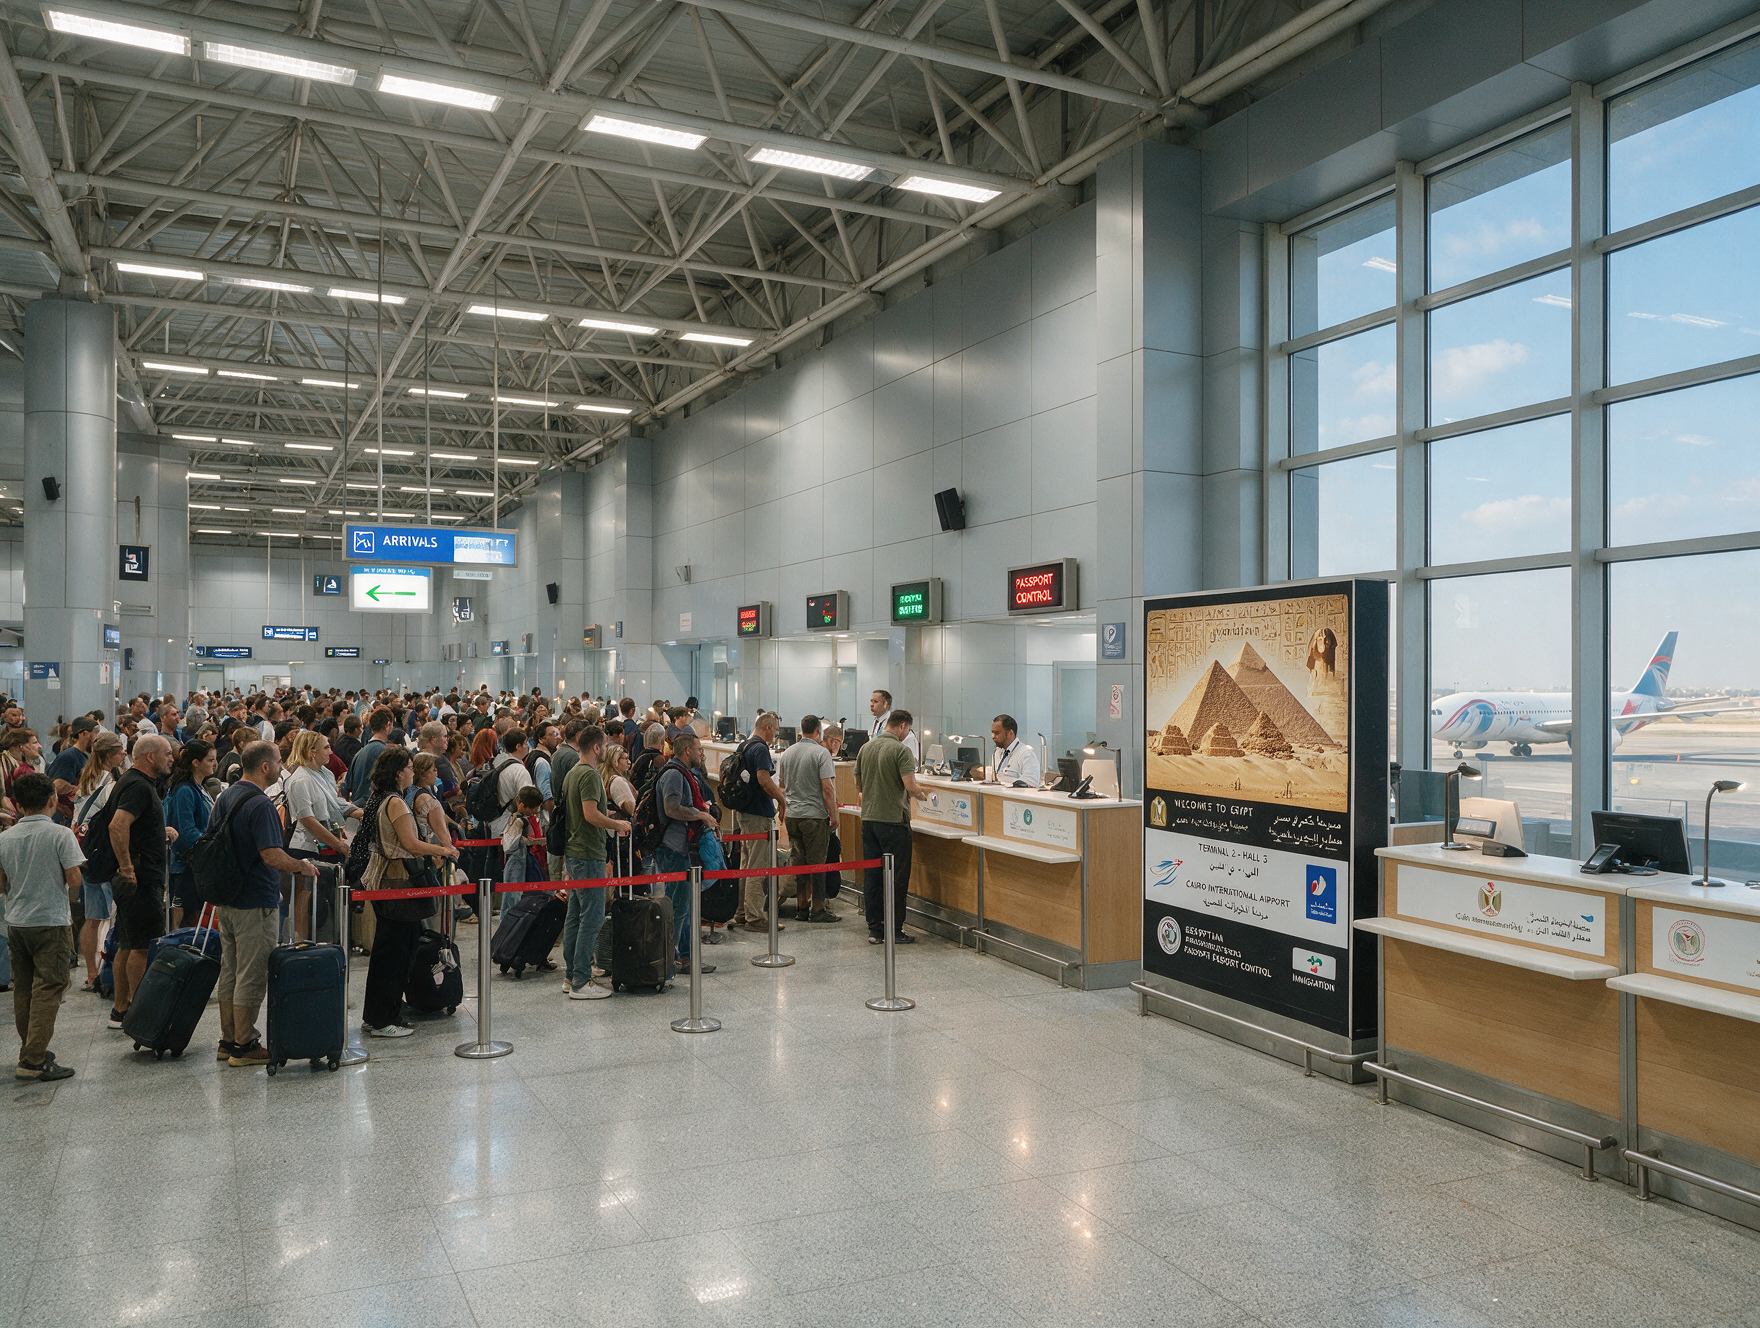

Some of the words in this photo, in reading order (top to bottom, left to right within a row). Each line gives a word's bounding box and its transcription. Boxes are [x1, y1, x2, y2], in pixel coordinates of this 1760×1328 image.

[383, 535, 438, 548] ARRIVALS
[1015, 573, 1054, 589] PASSPORT
[1016, 589, 1053, 604] CONTROL
[1216, 803, 1227, 814] TO
[1231, 849, 1237, 858] 2
[1242, 851, 1260, 863] HALL
